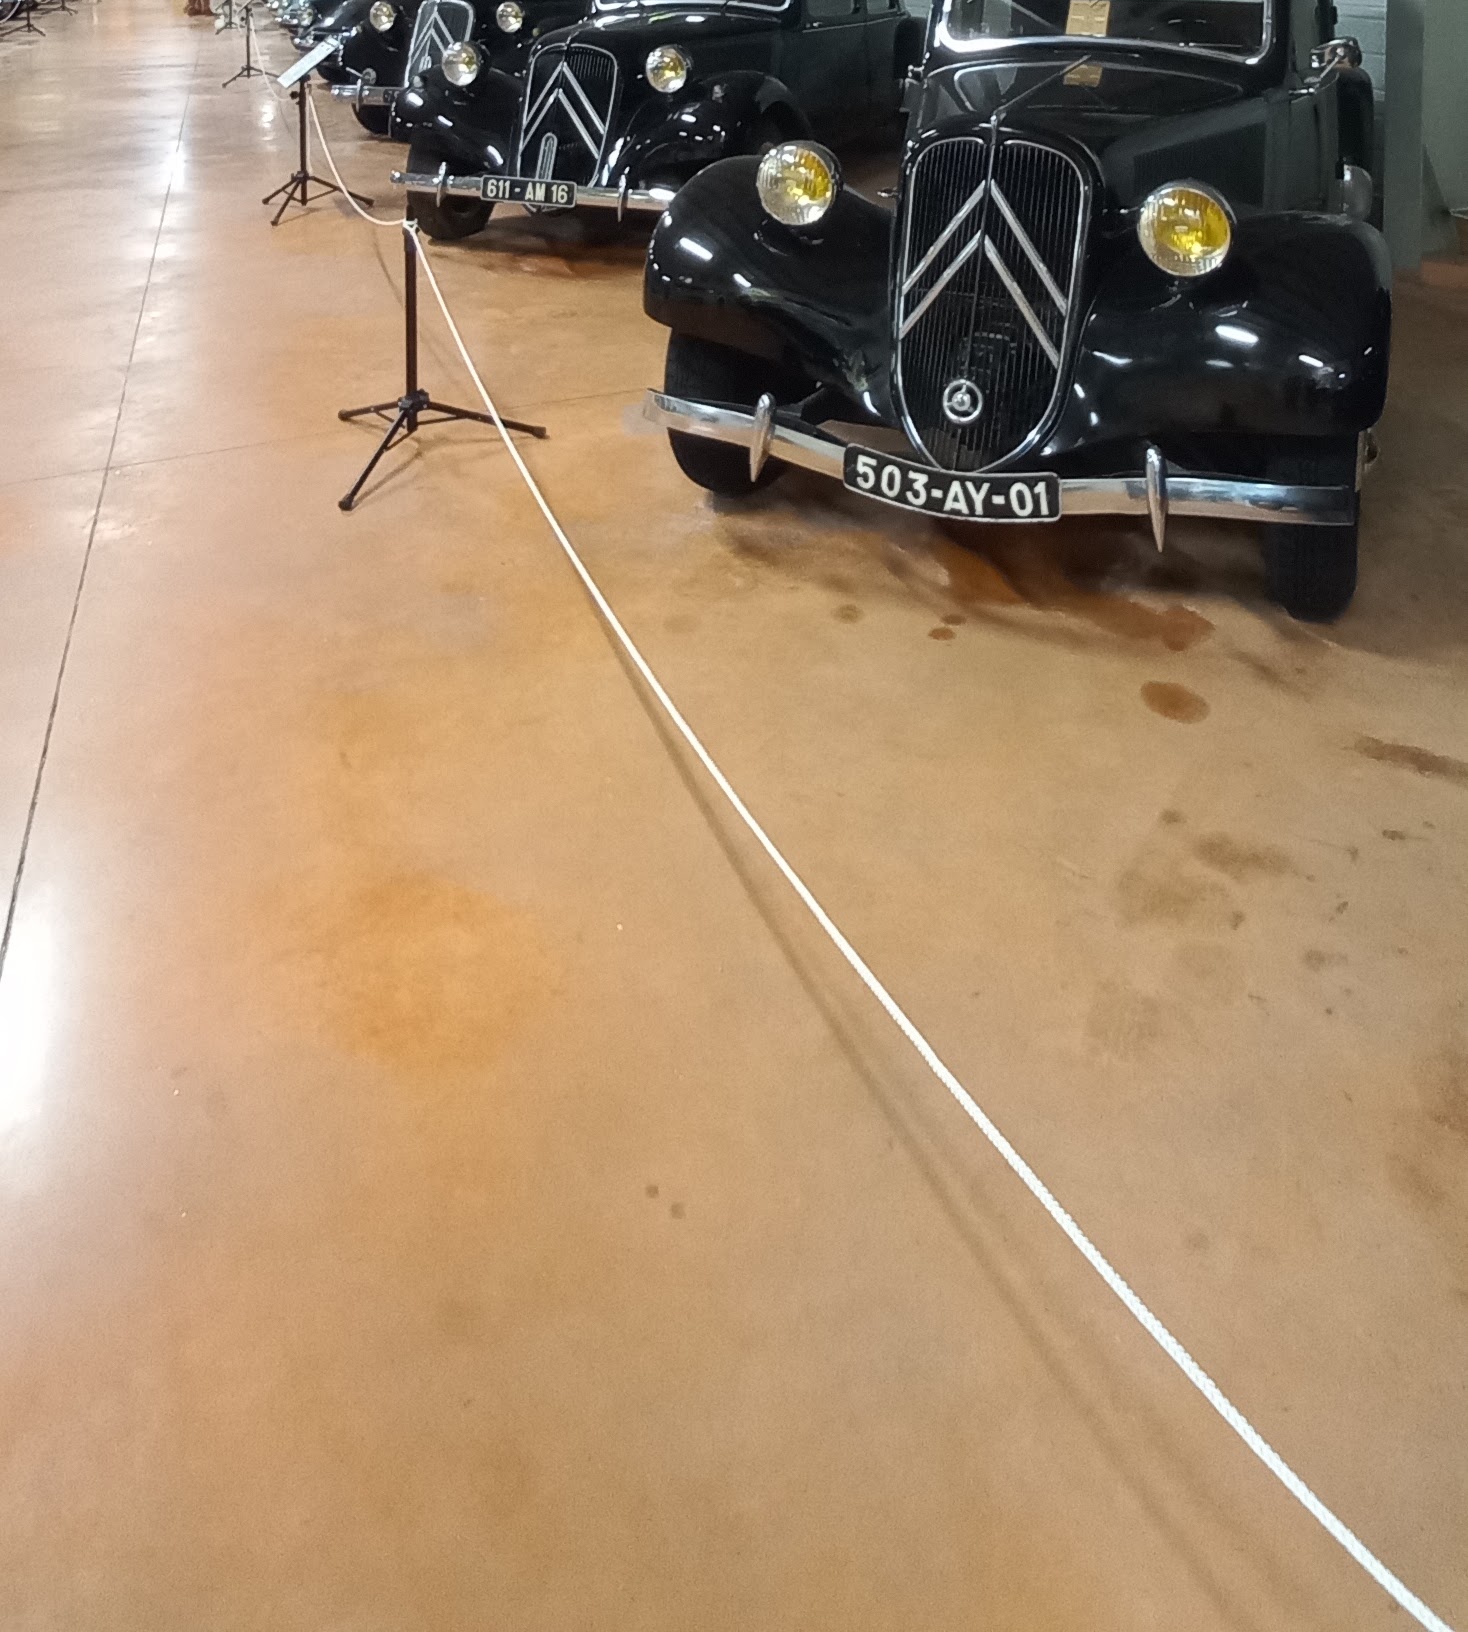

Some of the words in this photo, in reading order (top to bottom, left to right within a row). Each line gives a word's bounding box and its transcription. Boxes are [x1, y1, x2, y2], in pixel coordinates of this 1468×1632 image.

[487, 179, 510, 199] 611
[524, 181, 546, 202] AM
[551, 184, 568, 204] 16
[855, 454, 1049, 517] 503-AY-01
